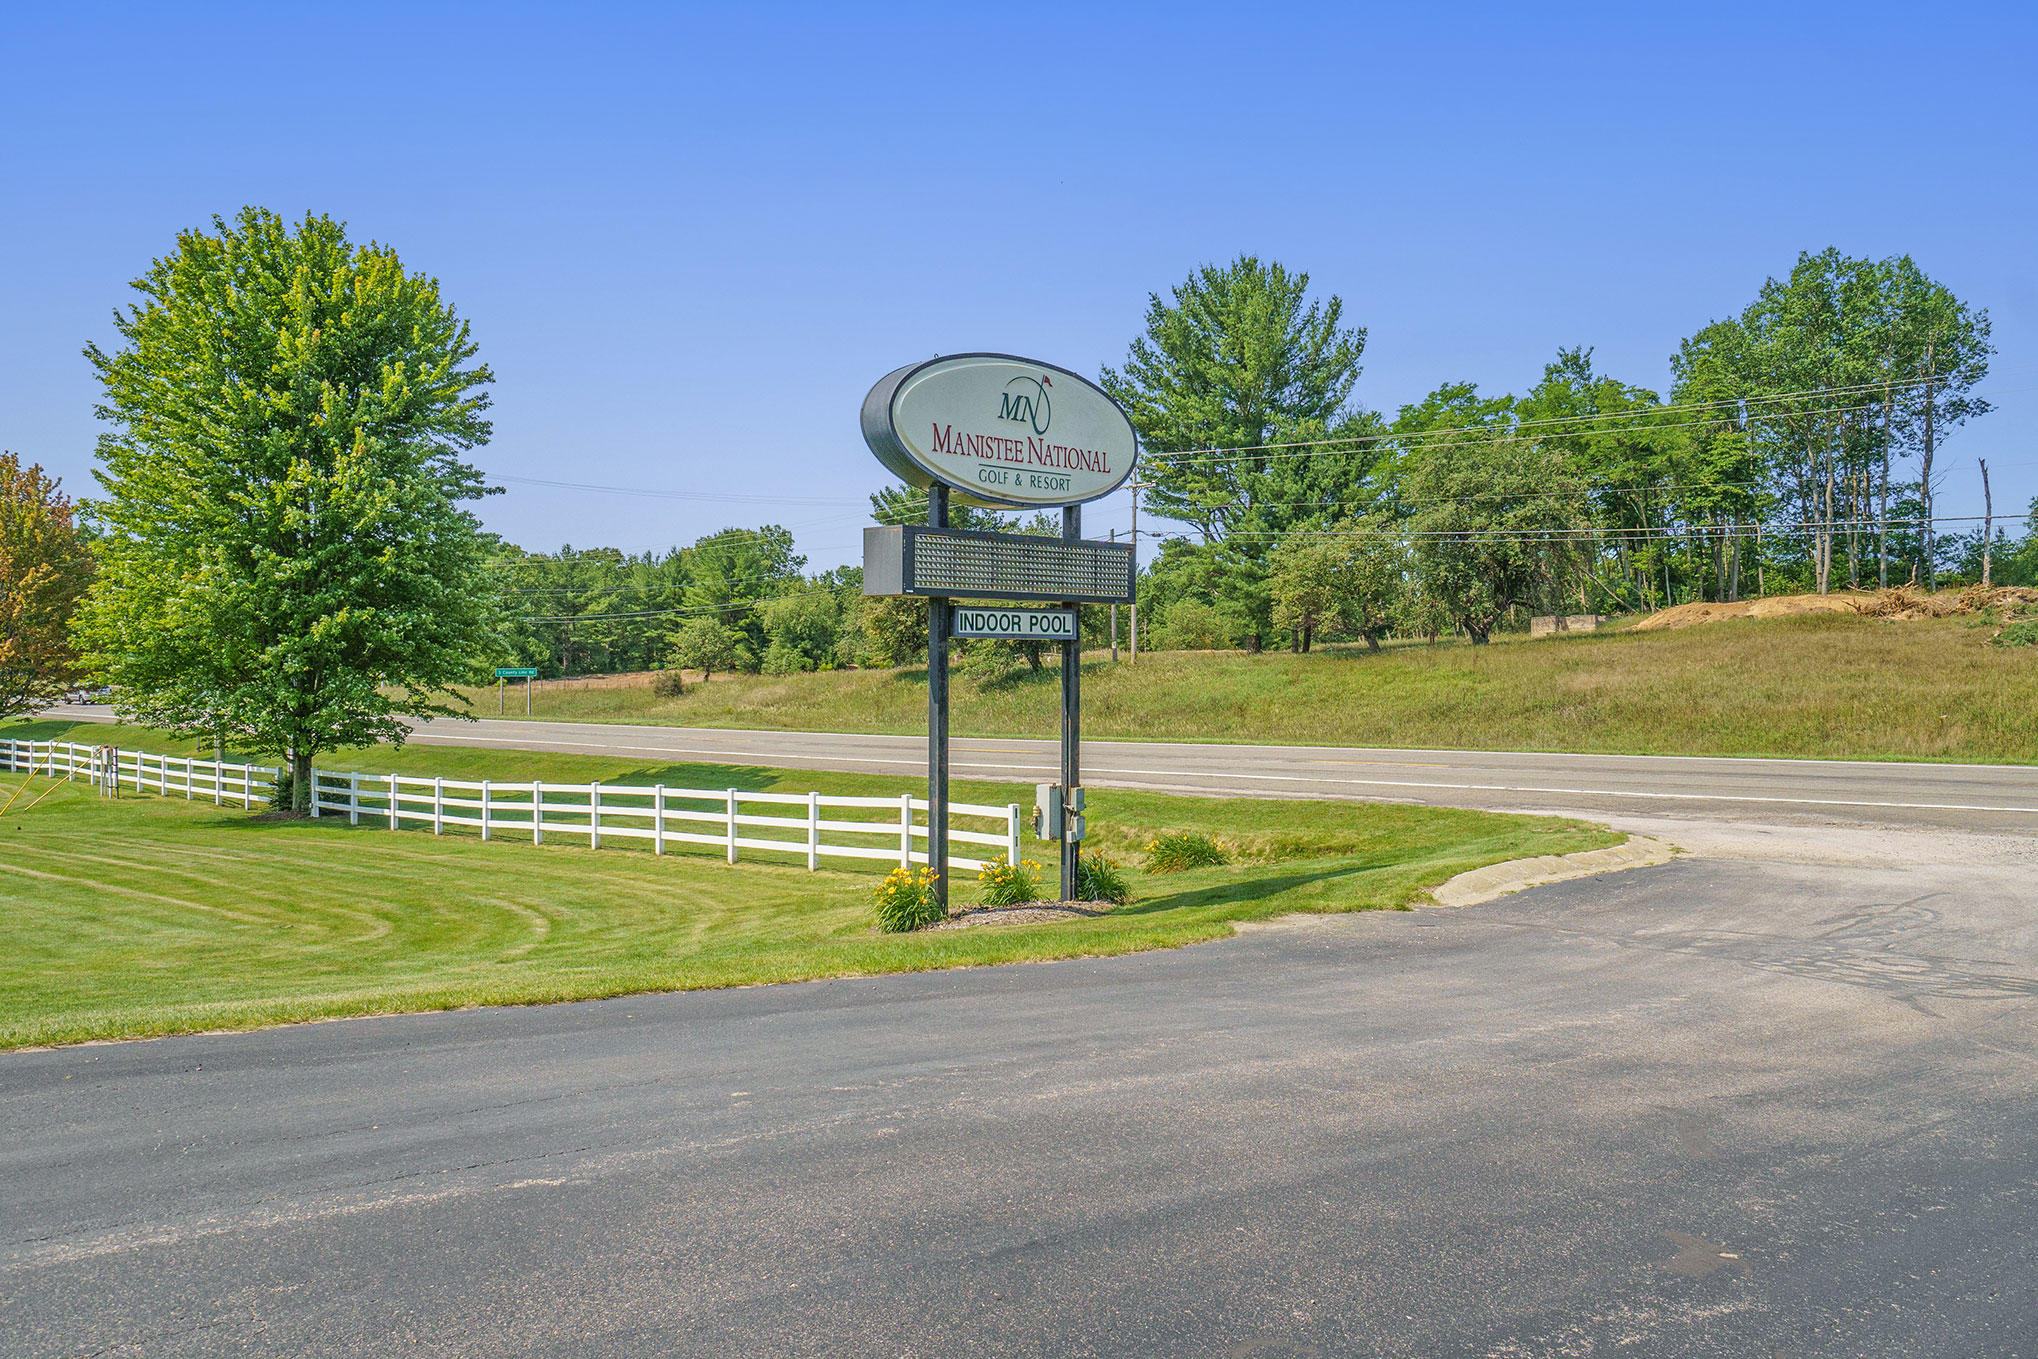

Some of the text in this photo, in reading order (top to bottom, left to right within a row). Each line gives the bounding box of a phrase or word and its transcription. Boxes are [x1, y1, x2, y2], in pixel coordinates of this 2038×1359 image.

[978, 468, 1071, 492] GOLF & RESORT
[959, 611, 1071, 633] INDOOR POOL
